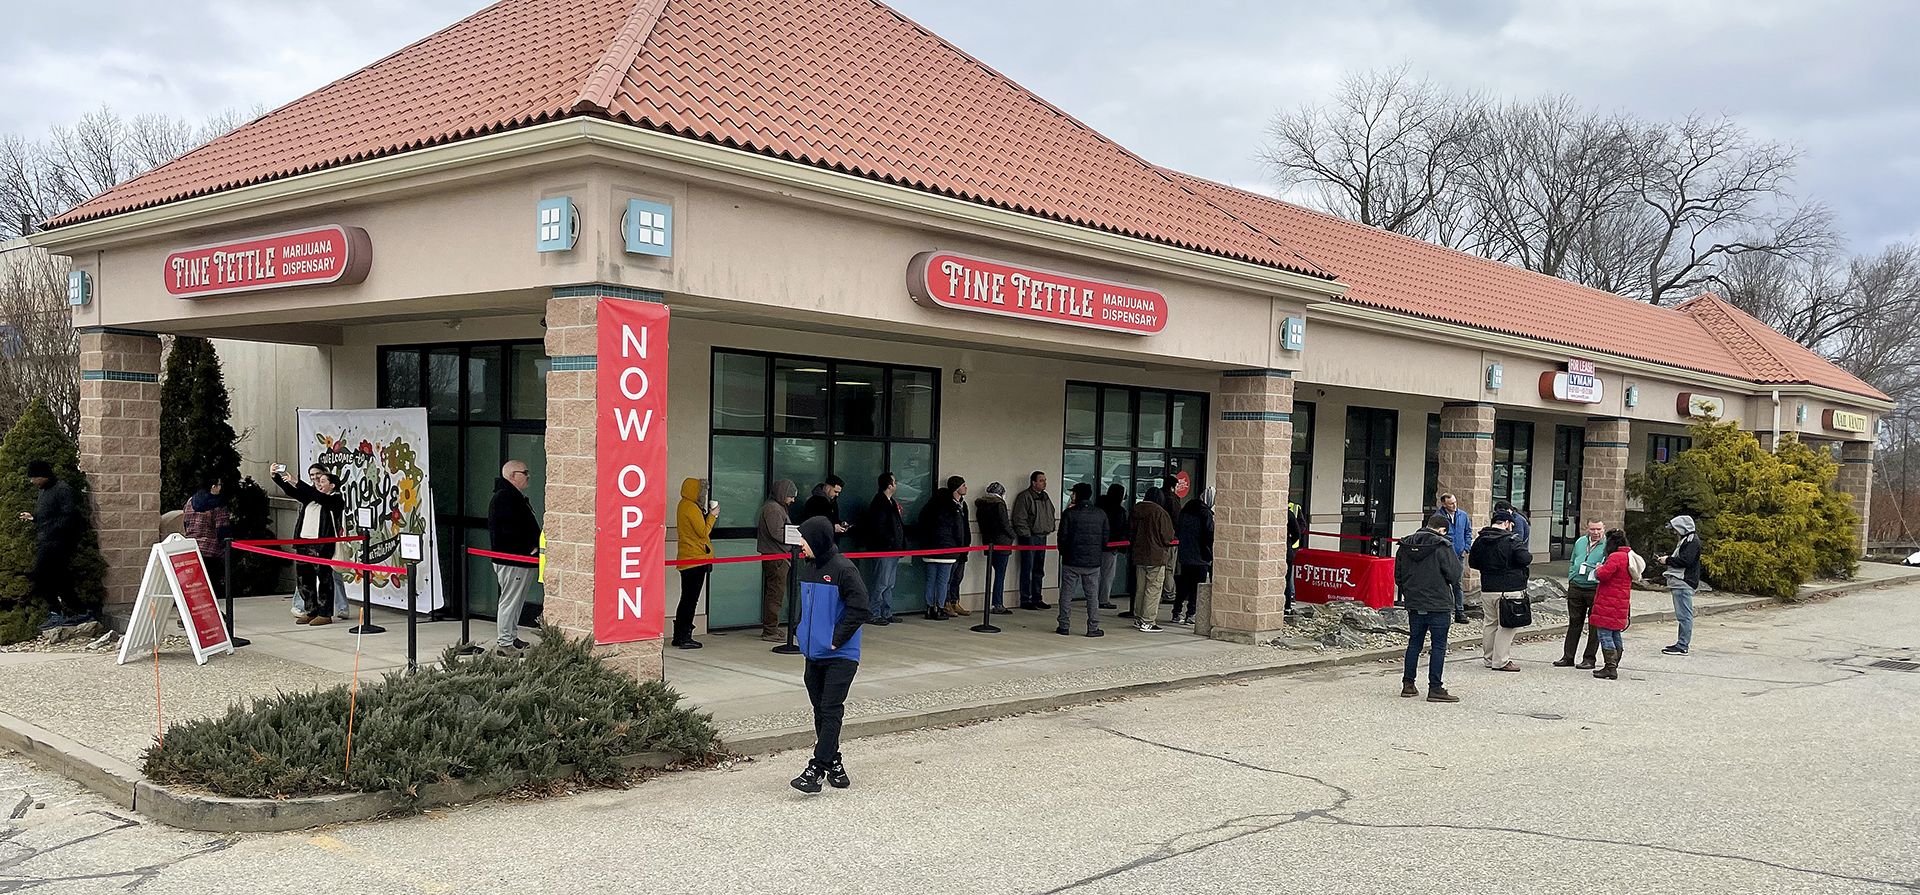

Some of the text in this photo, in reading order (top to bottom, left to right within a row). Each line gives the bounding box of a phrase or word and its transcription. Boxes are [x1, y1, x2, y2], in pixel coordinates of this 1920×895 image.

[282, 240, 332, 258] MARIJUANA
[171, 247, 276, 289] FINE FETTLE
[282, 257, 335, 276] DISPENSARY
[941, 260, 1094, 318] FINE FETTLE
[1102, 293, 1155, 313] MARIJUANA
[1102, 308, 1157, 327] DISPENSARY
[1570, 358, 1593, 374] FOR LEASE
[1569, 373, 1593, 387] LYMAN
[613, 324, 653, 620] NOW OPEN
[1303, 564, 1356, 587] FETTLE
[1312, 580, 1343, 589] DISPENSARY
